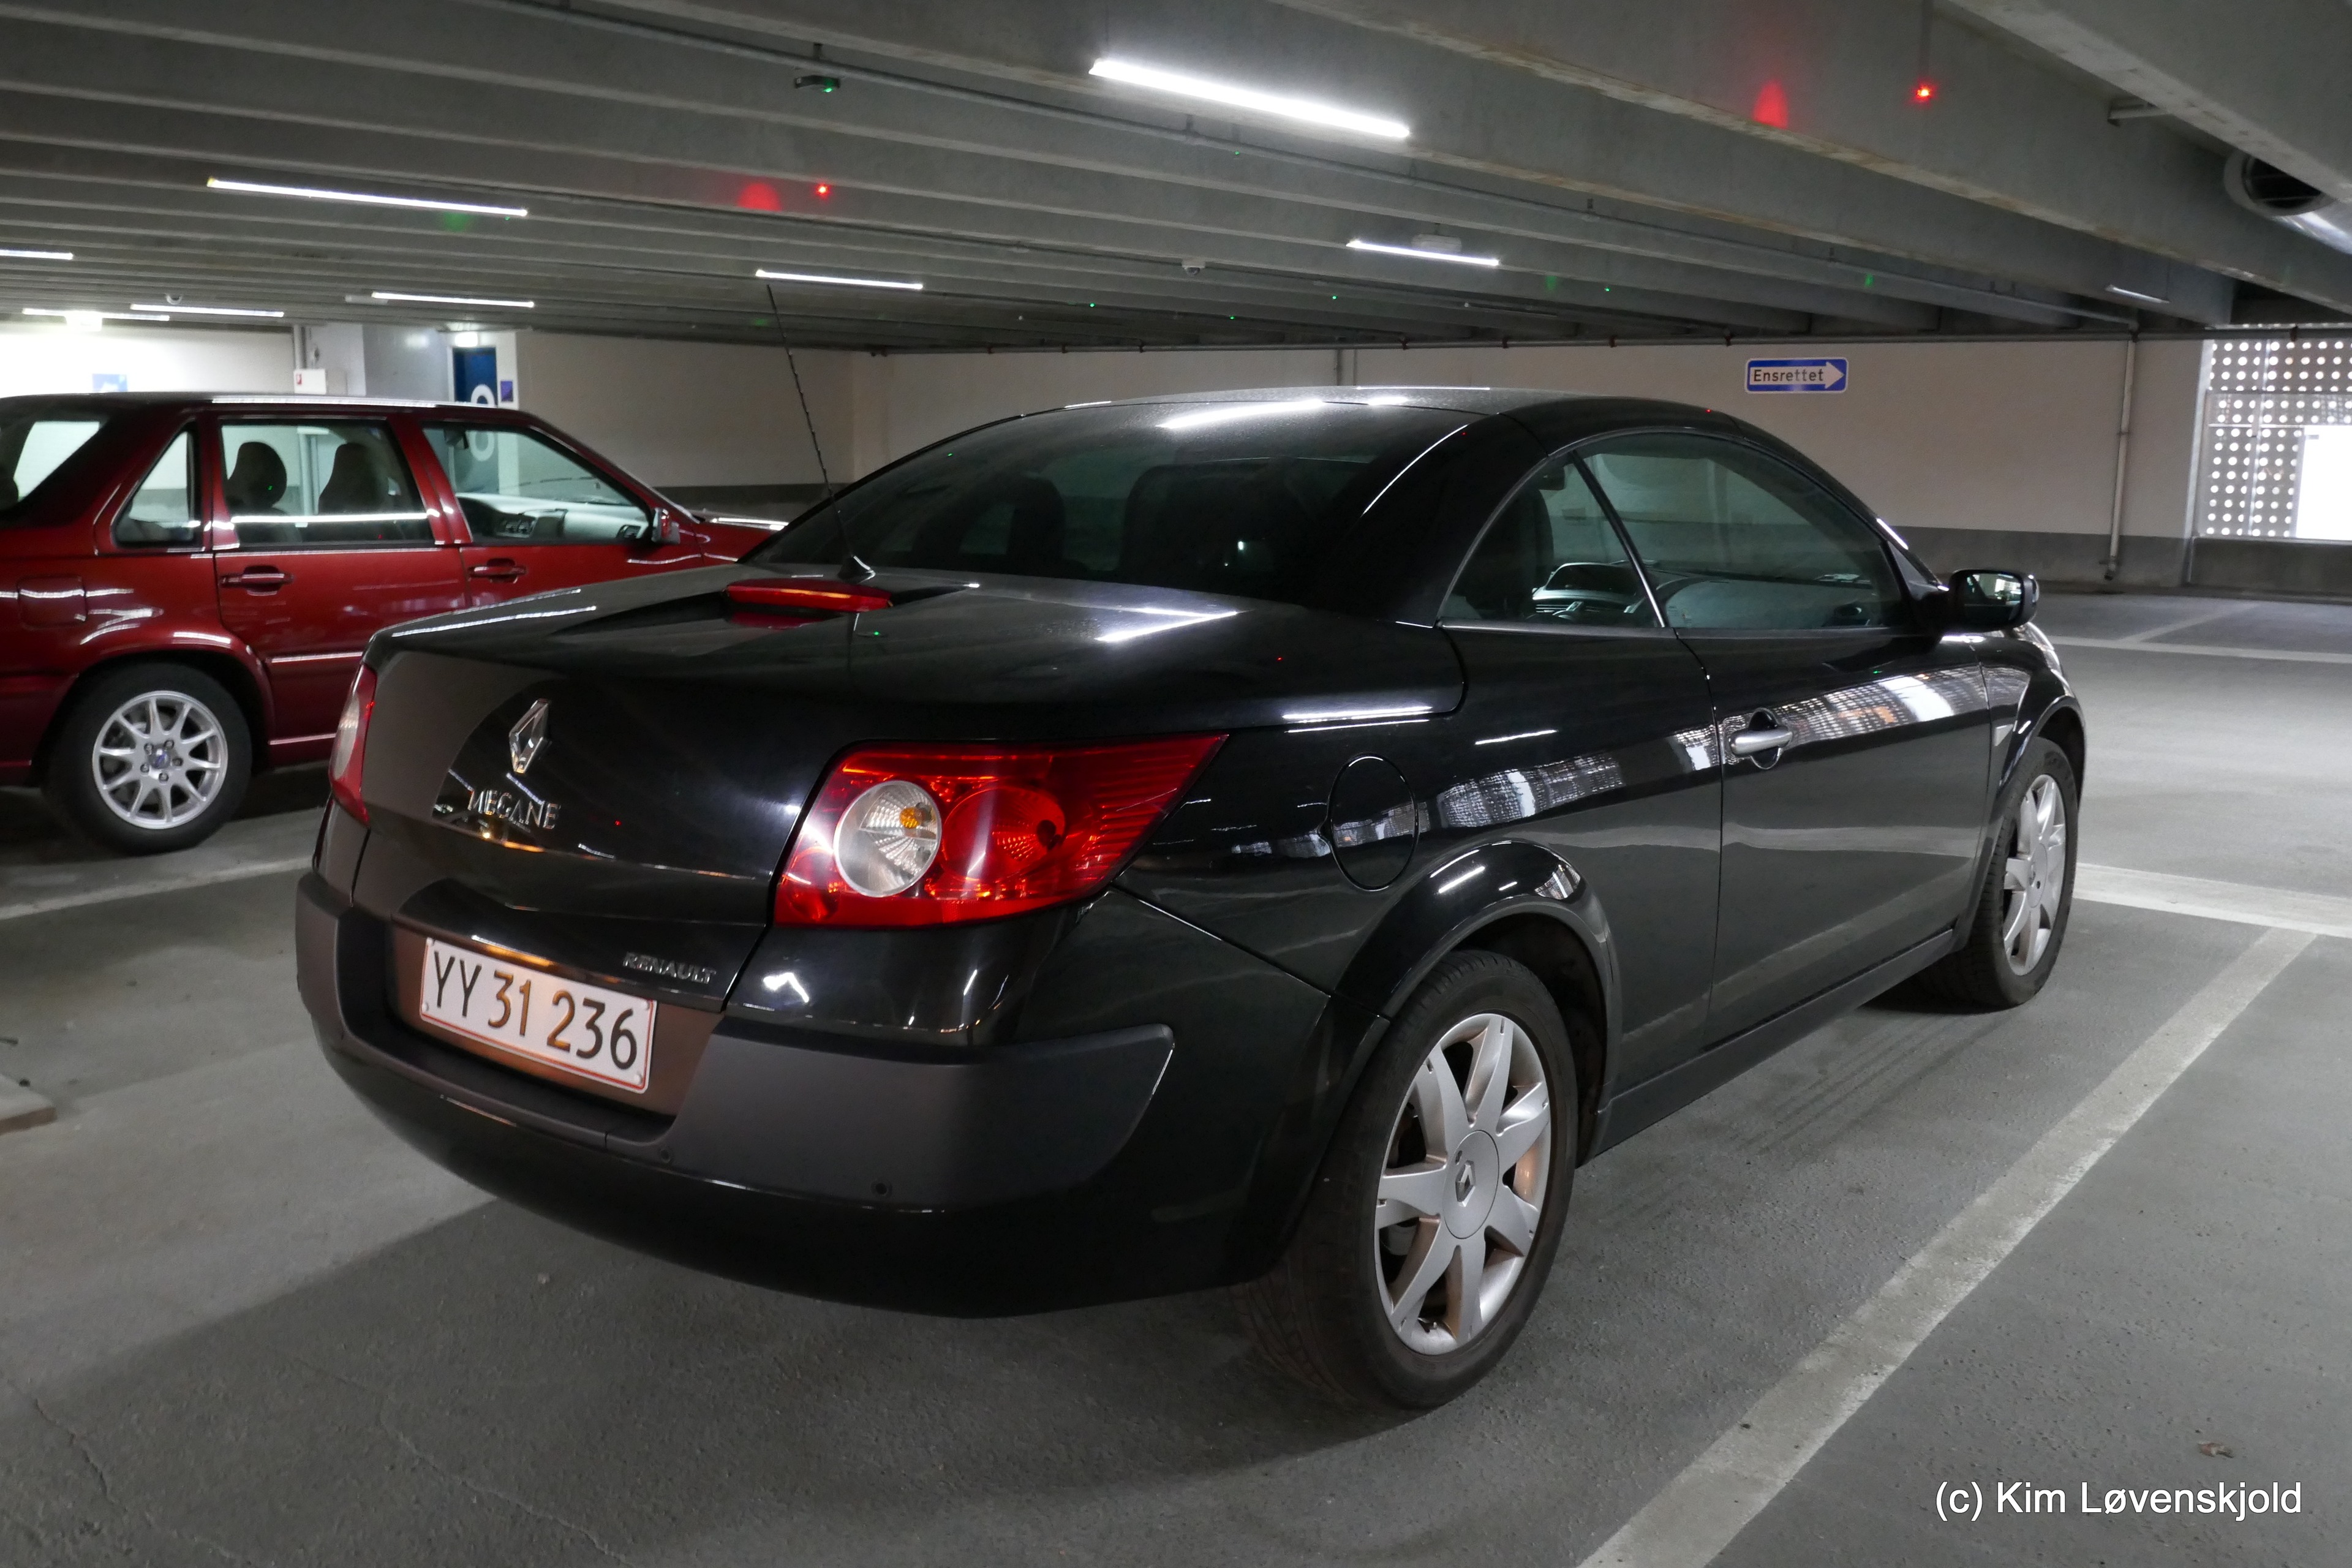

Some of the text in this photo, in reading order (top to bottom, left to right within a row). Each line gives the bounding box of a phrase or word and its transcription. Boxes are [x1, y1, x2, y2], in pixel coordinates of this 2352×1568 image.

[1754, 369, 1824, 382] Ensrettet
[467, 789, 561, 830] MEGANE
[622, 951, 717, 984] RENAULT
[433, 951, 638, 1070] YY 31 236
